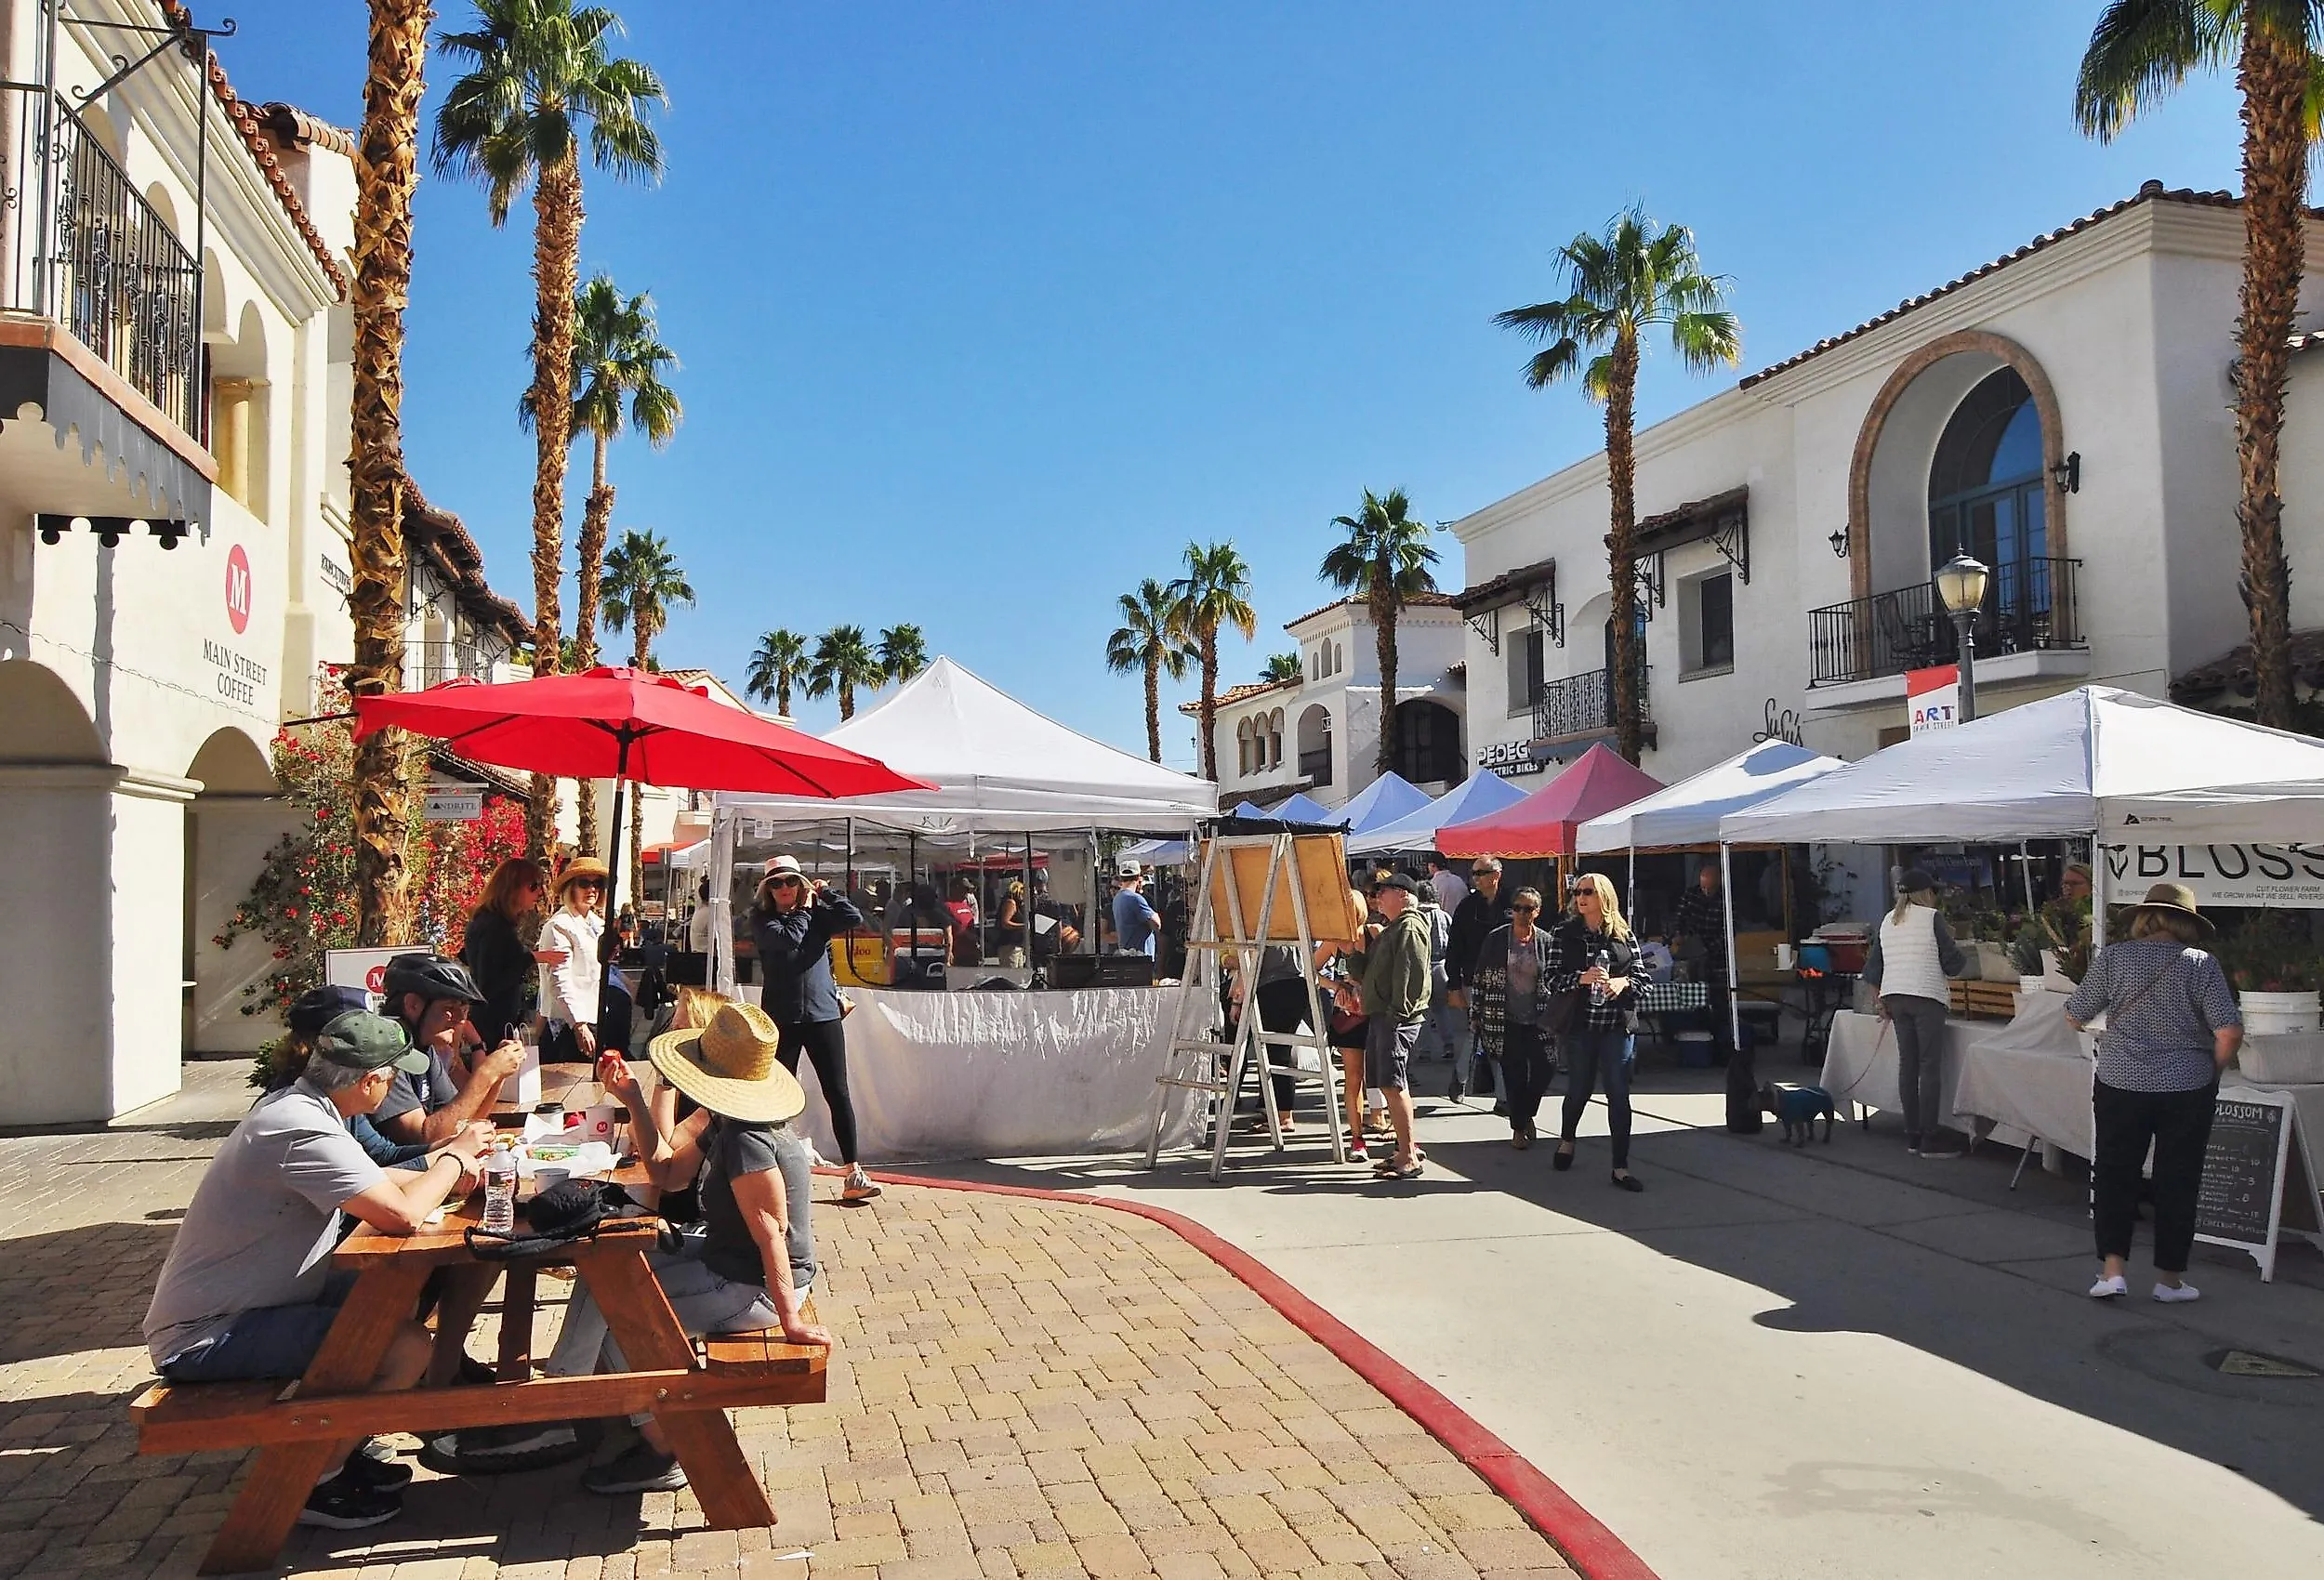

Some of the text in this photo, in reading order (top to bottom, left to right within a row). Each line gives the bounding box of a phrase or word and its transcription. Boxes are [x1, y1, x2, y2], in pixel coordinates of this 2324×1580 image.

[230, 563, 247, 615] M
[203, 639, 267, 685] MAIN STREET
[218, 673, 254, 705] COFFEE
[1914, 705, 1955, 725] ART
[1475, 740, 1532, 767] PEDEG
[1489, 762, 1538, 777] CTRIC BIKES
